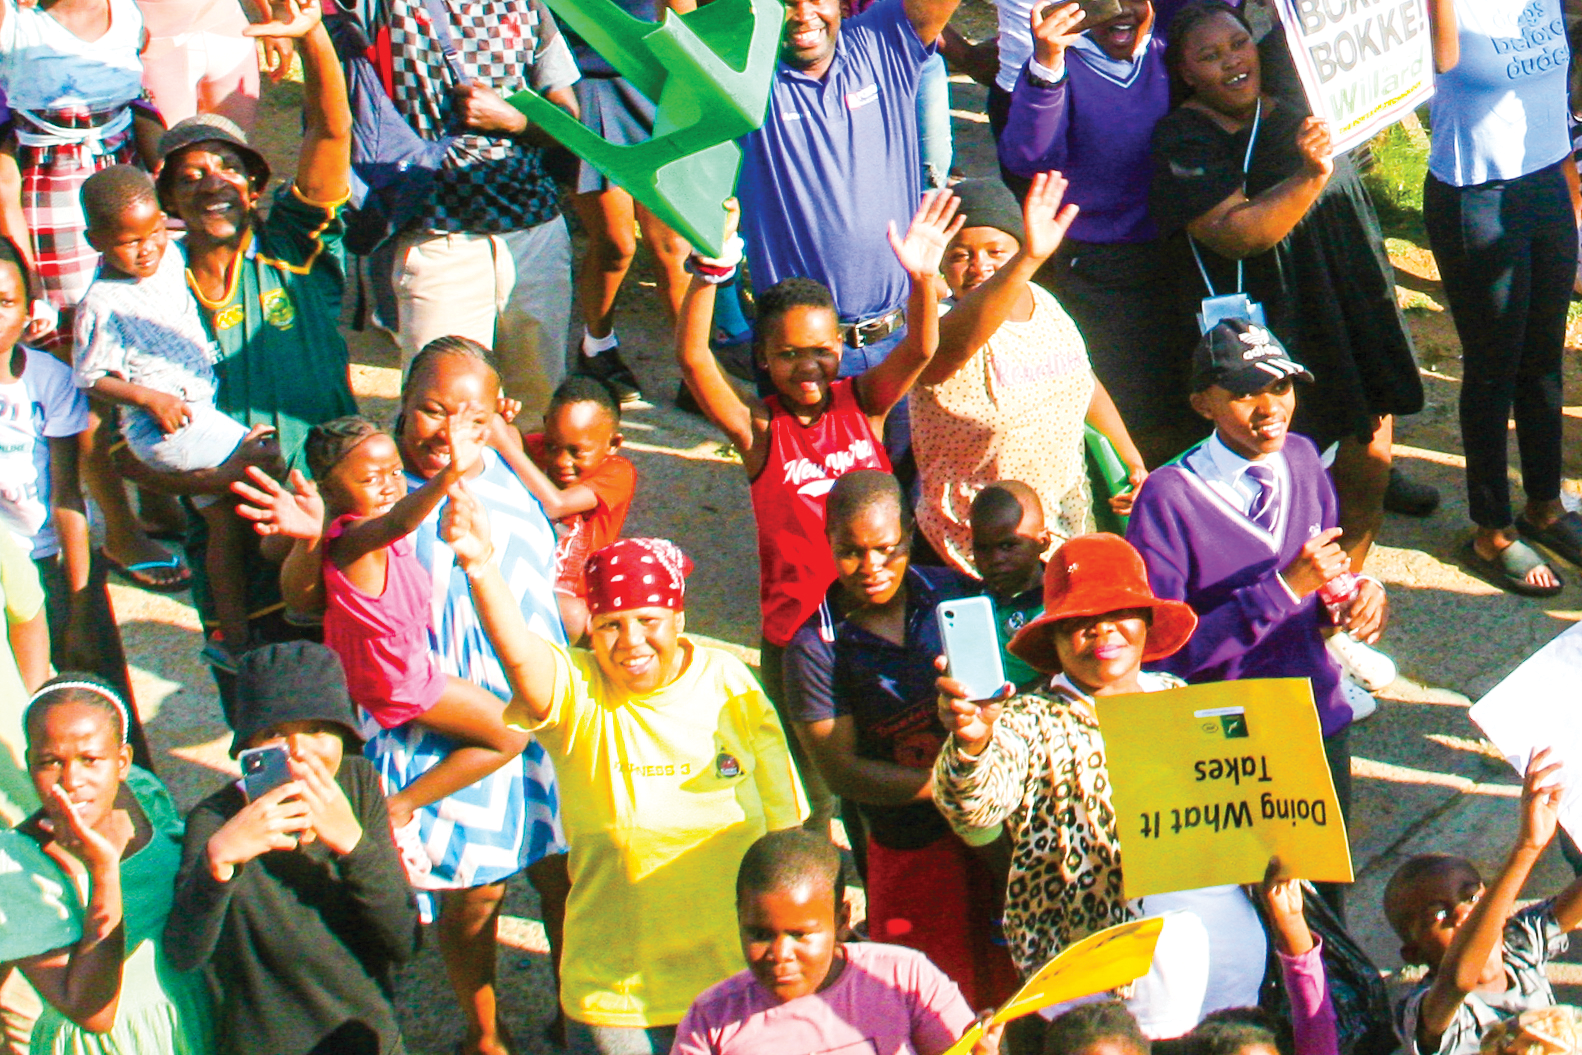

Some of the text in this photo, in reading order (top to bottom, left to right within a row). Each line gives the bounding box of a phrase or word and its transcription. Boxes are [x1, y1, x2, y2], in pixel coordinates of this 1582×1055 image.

[1243, 344, 1283, 360] adidas
[782, 457, 826, 486] New
[1194, 755, 1273, 786] Takes
[1140, 792, 1327, 839] Doing What It
